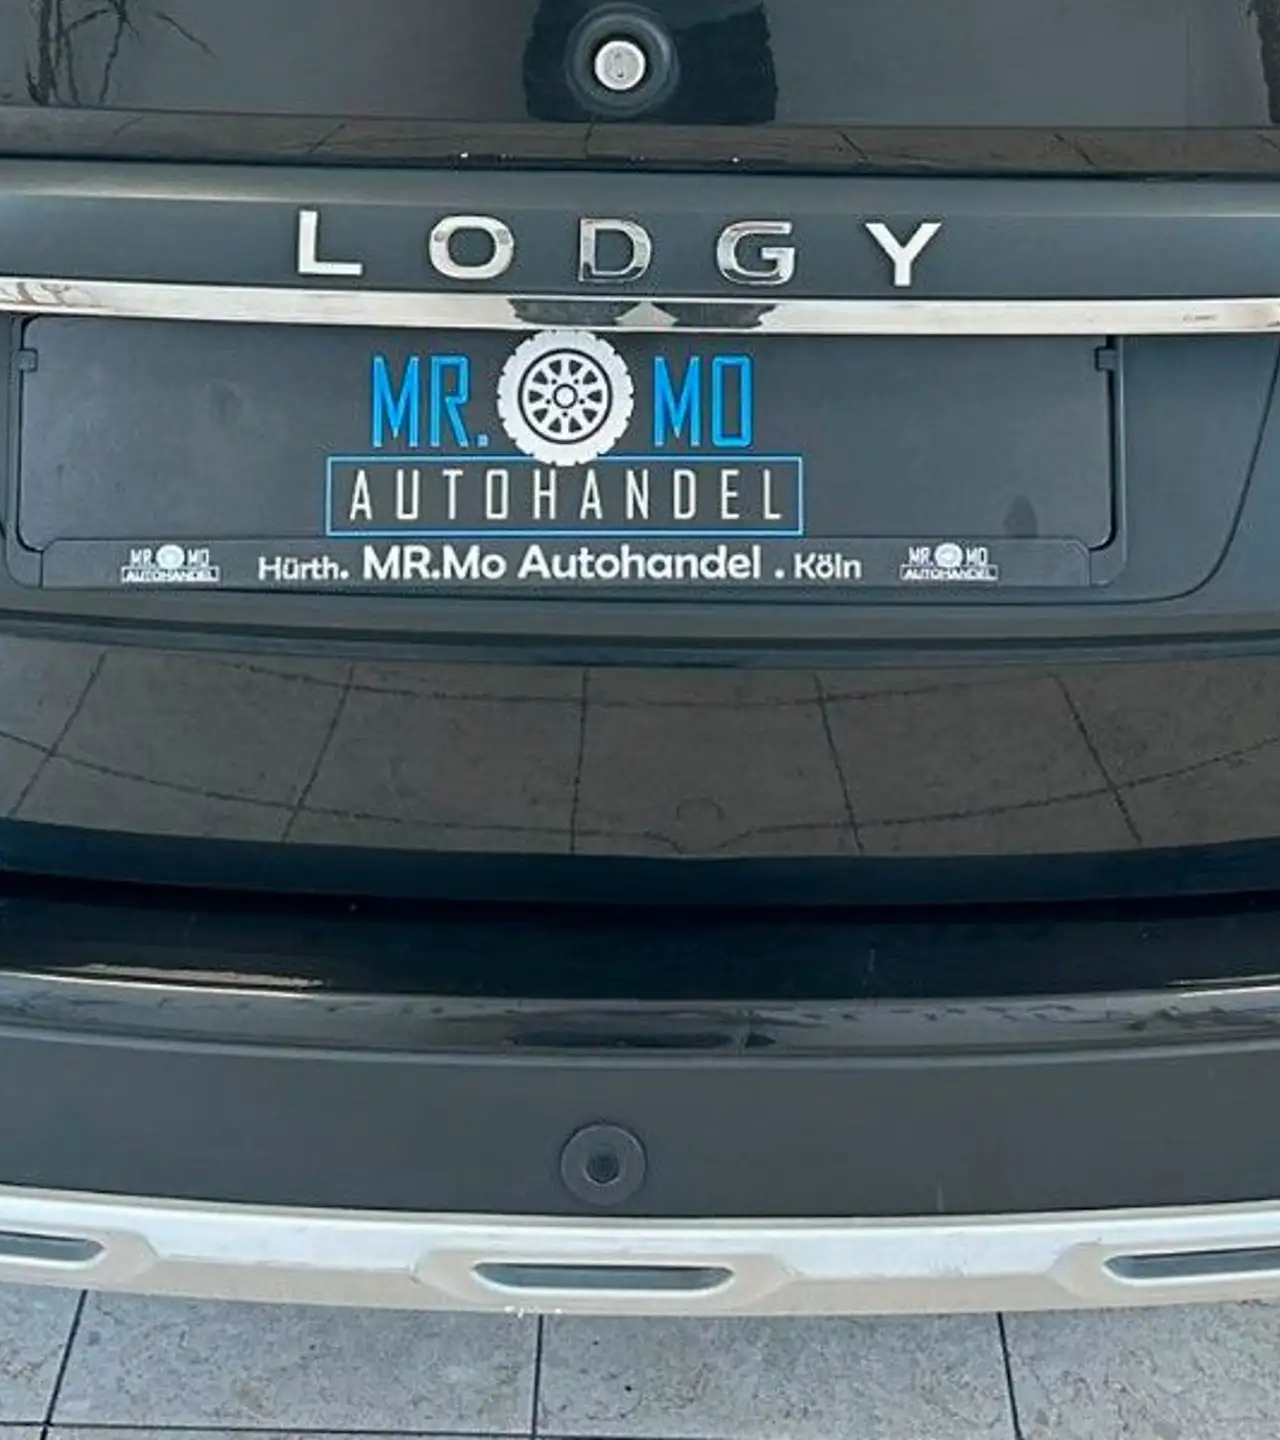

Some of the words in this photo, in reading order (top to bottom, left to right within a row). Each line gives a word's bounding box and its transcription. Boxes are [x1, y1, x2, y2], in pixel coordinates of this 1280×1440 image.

[296, 210, 942, 287] LODGY
[372, 356, 488, 448] MR.
[653, 356, 754, 448] MO
[349, 468, 782, 520] AUTOHANDEL
[258, 556, 350, 580] Hürth.
[363, 545, 507, 580] MR.Mo
[517, 544, 761, 580] Autohandel
[794, 553, 862, 580] Köln
